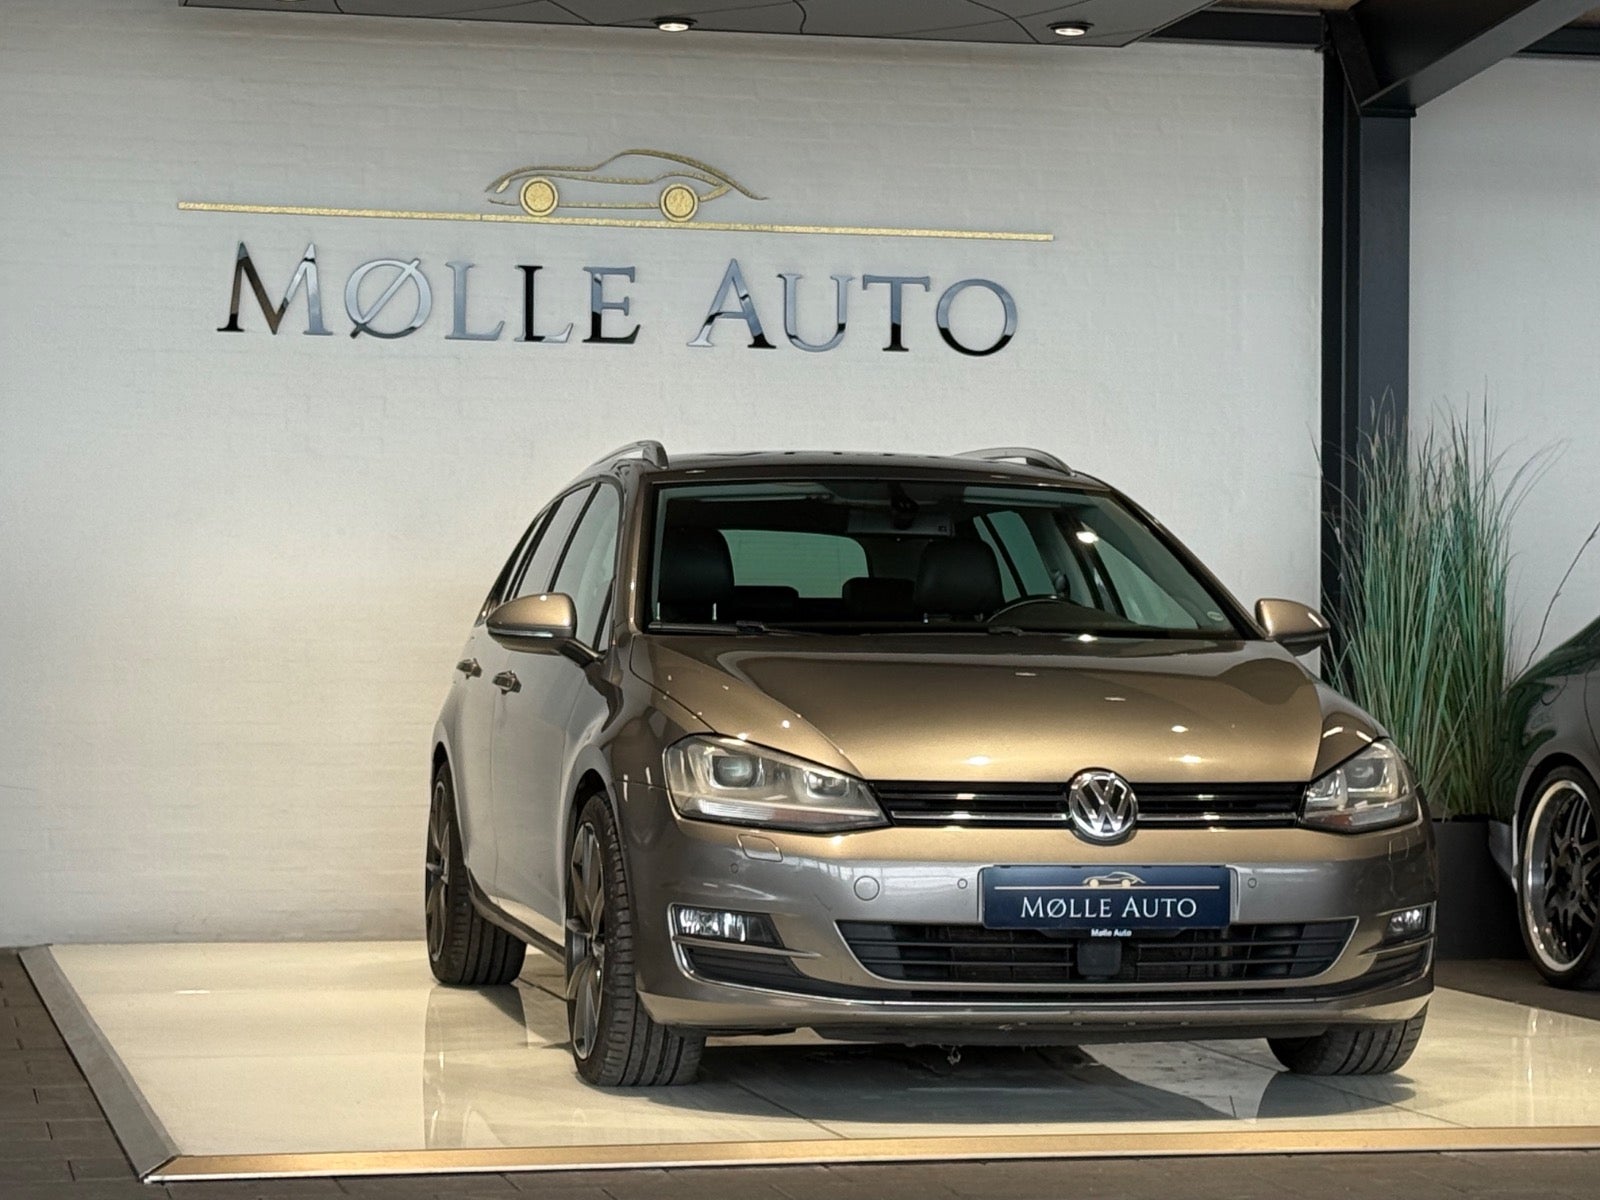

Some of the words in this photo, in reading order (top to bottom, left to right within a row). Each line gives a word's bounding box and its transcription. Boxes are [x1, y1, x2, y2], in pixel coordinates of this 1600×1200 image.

[216, 241, 642, 344] MØLLE
[687, 257, 1020, 356] AUTO
[1020, 896, 1113, 918] MØLLE
[1121, 896, 1197, 918] AUTO
